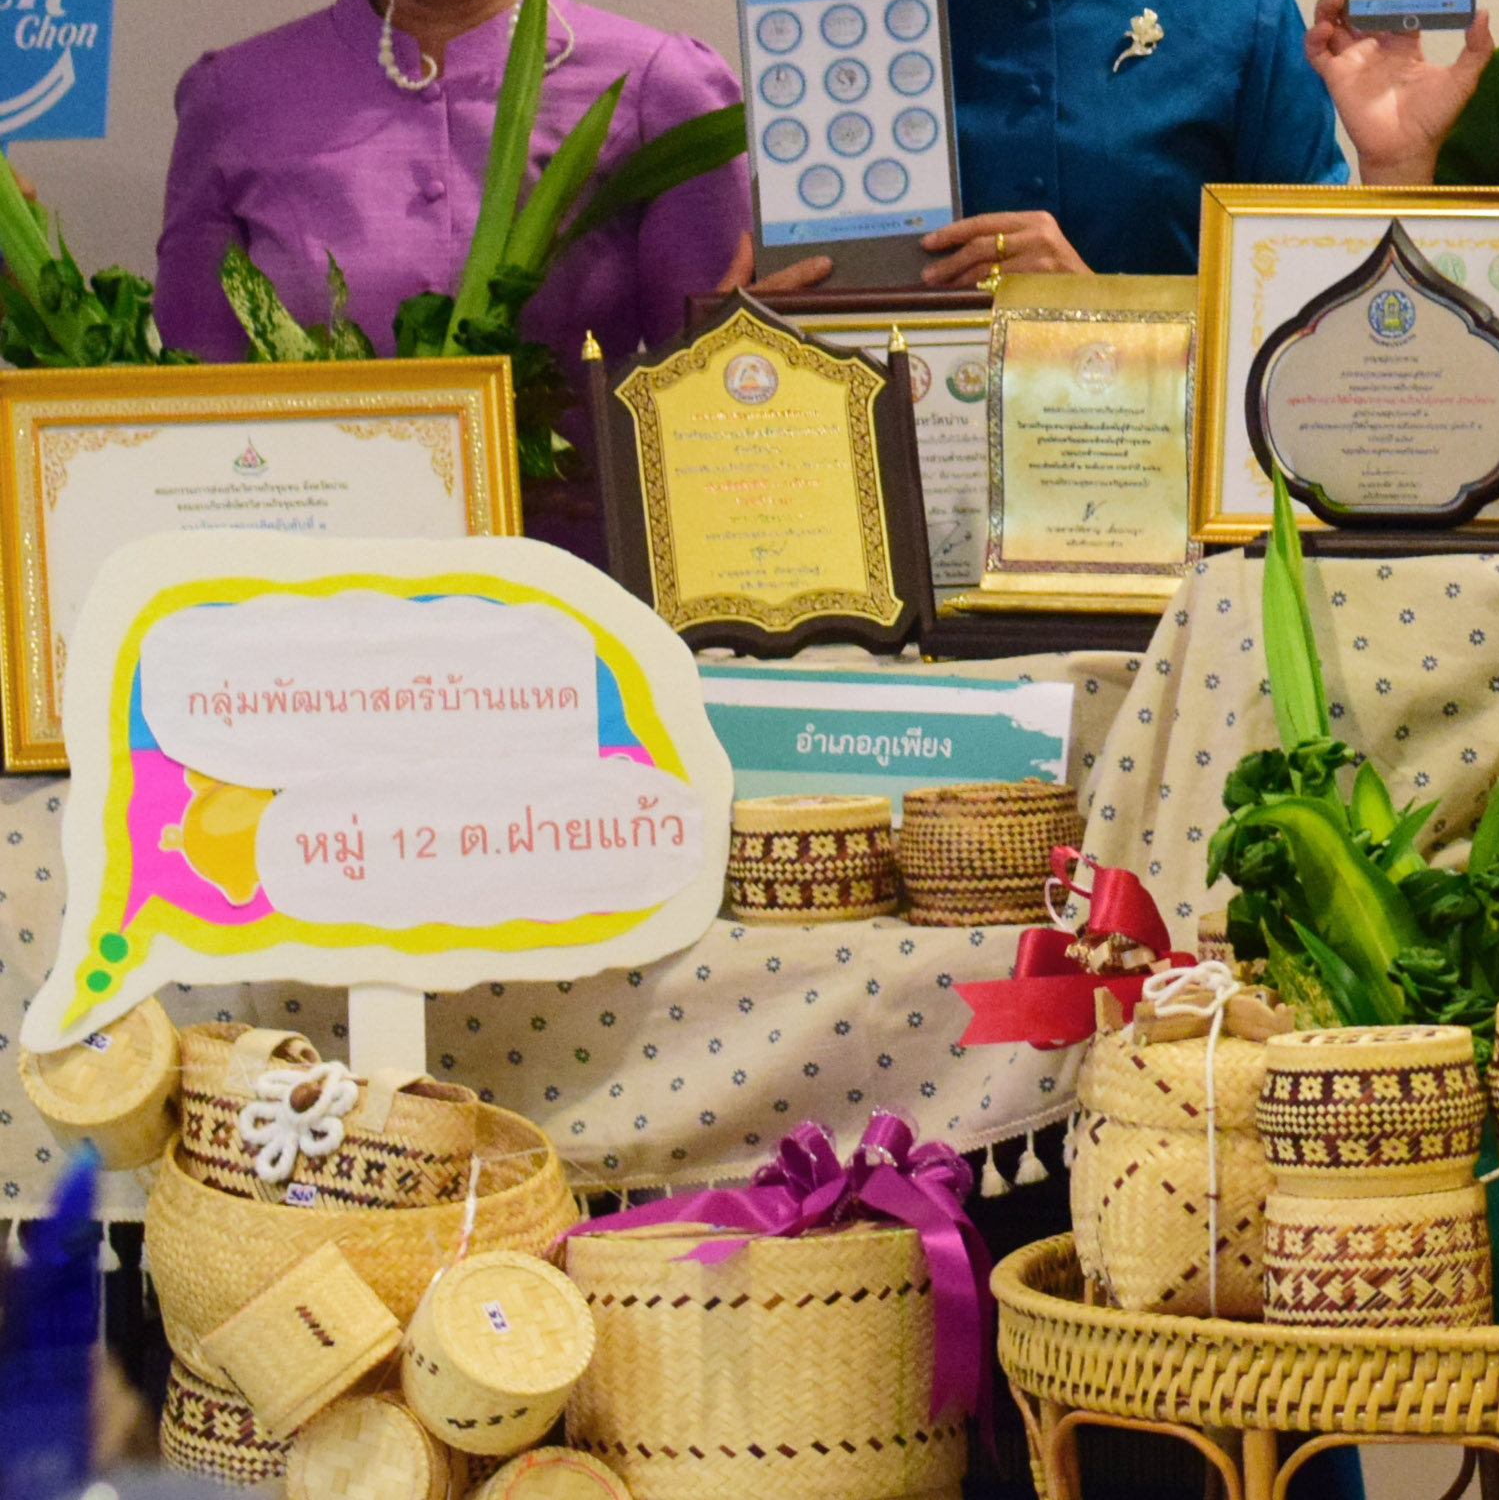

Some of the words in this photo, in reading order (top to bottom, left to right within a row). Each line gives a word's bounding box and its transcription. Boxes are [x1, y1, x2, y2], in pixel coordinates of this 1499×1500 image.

[15, 15, 98, 50] Chon
[187, 673, 580, 729] กลุ่มพัฒนาสตรีบ้านแหด
[796, 724, 952, 767] อำเภอภูเพียง
[295, 812, 366, 880] หมู่
[391, 827, 437, 861] 12
[459, 794, 686, 857] ต.ฝายแก้ว
